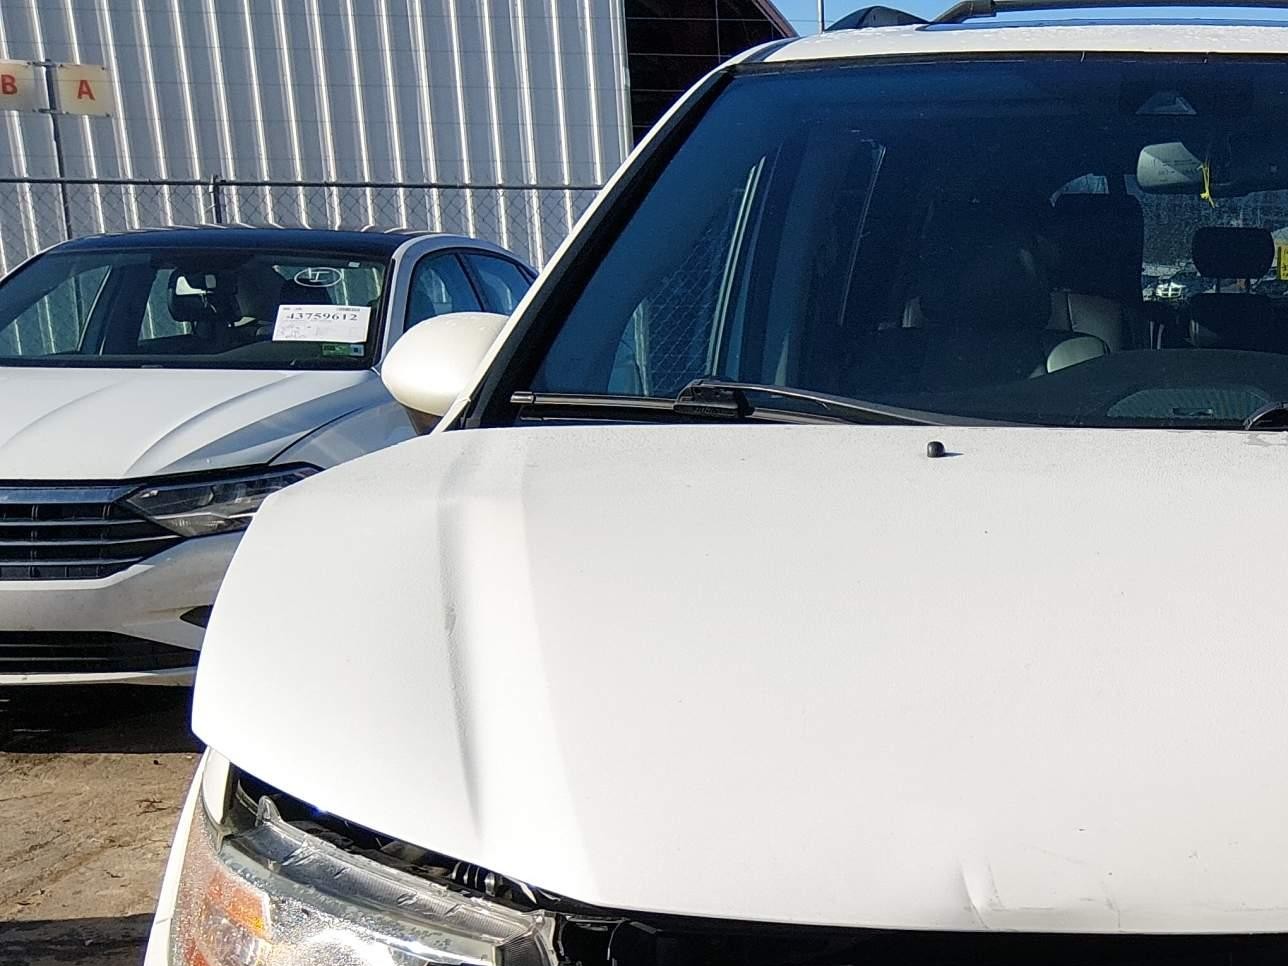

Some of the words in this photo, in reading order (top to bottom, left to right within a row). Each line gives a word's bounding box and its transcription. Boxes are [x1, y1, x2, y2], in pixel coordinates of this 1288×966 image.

[0, 74, 18, 95] B
[77, 79, 96, 101] A
[287, 312, 359, 321] 43759612
